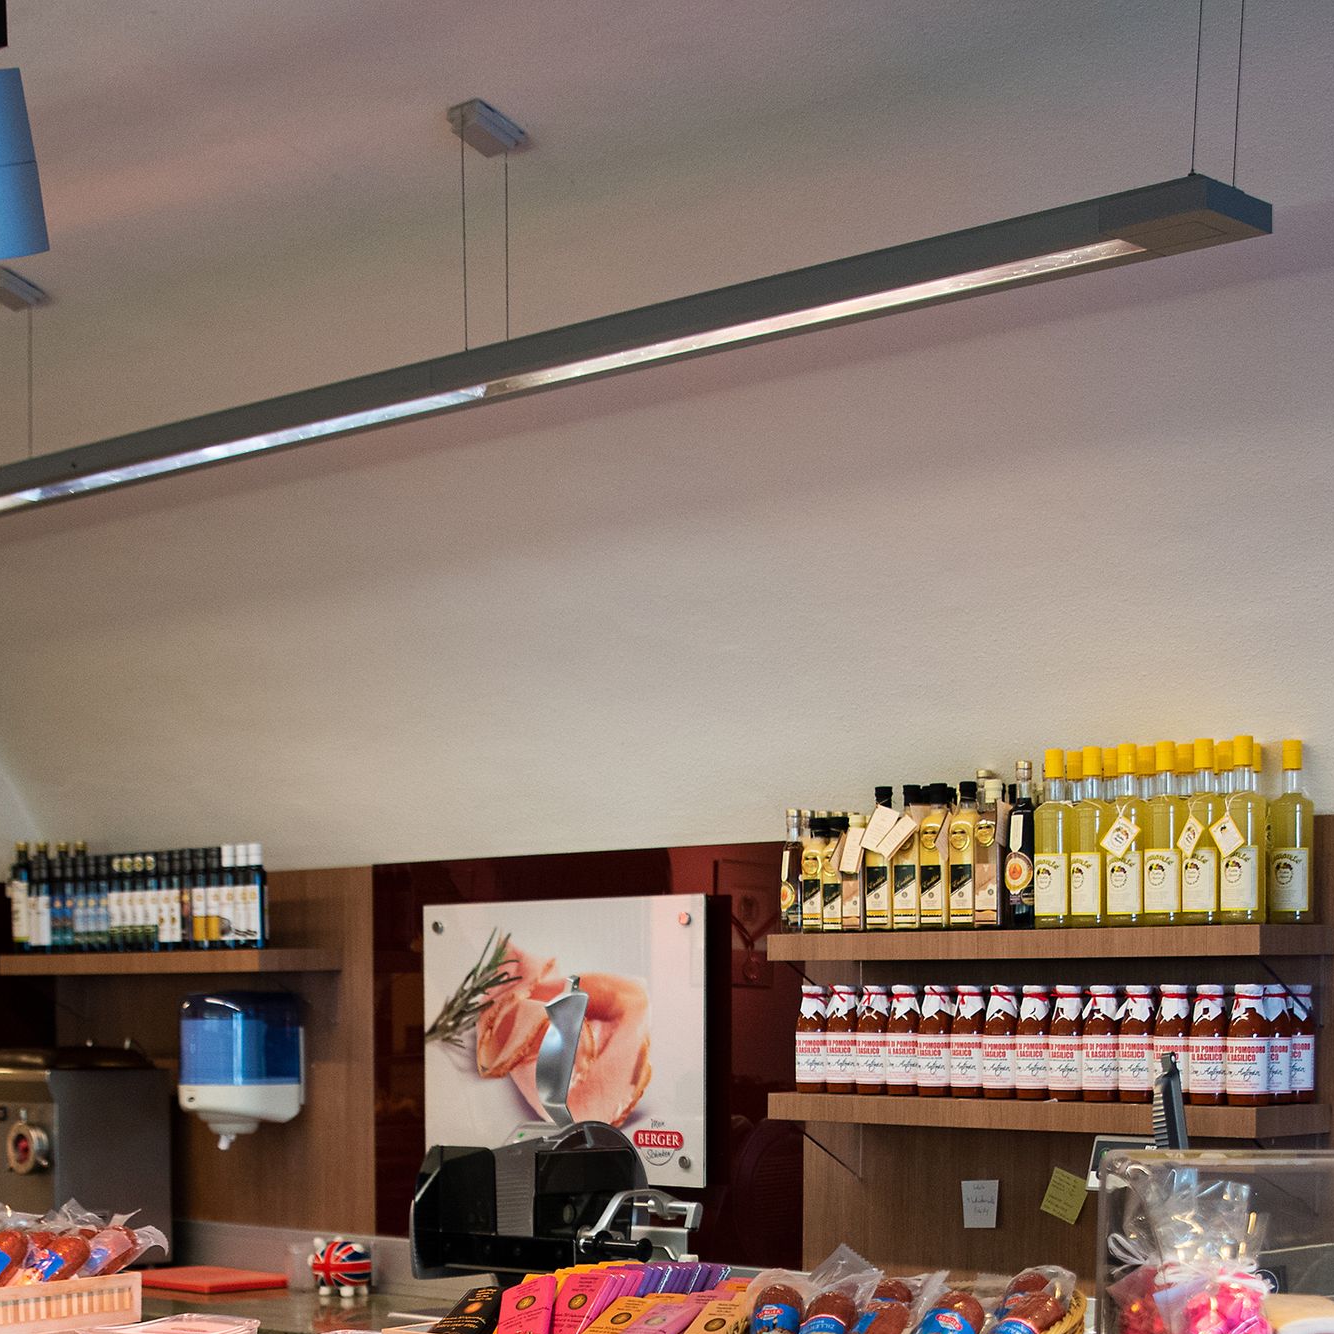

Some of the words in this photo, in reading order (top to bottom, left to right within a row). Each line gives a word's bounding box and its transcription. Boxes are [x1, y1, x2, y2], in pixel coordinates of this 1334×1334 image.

[1230, 1053, 1256, 1061] BASILICO
[637, 1132, 680, 1147] BERGER
[937, 1314, 963, 1331] BERGER
